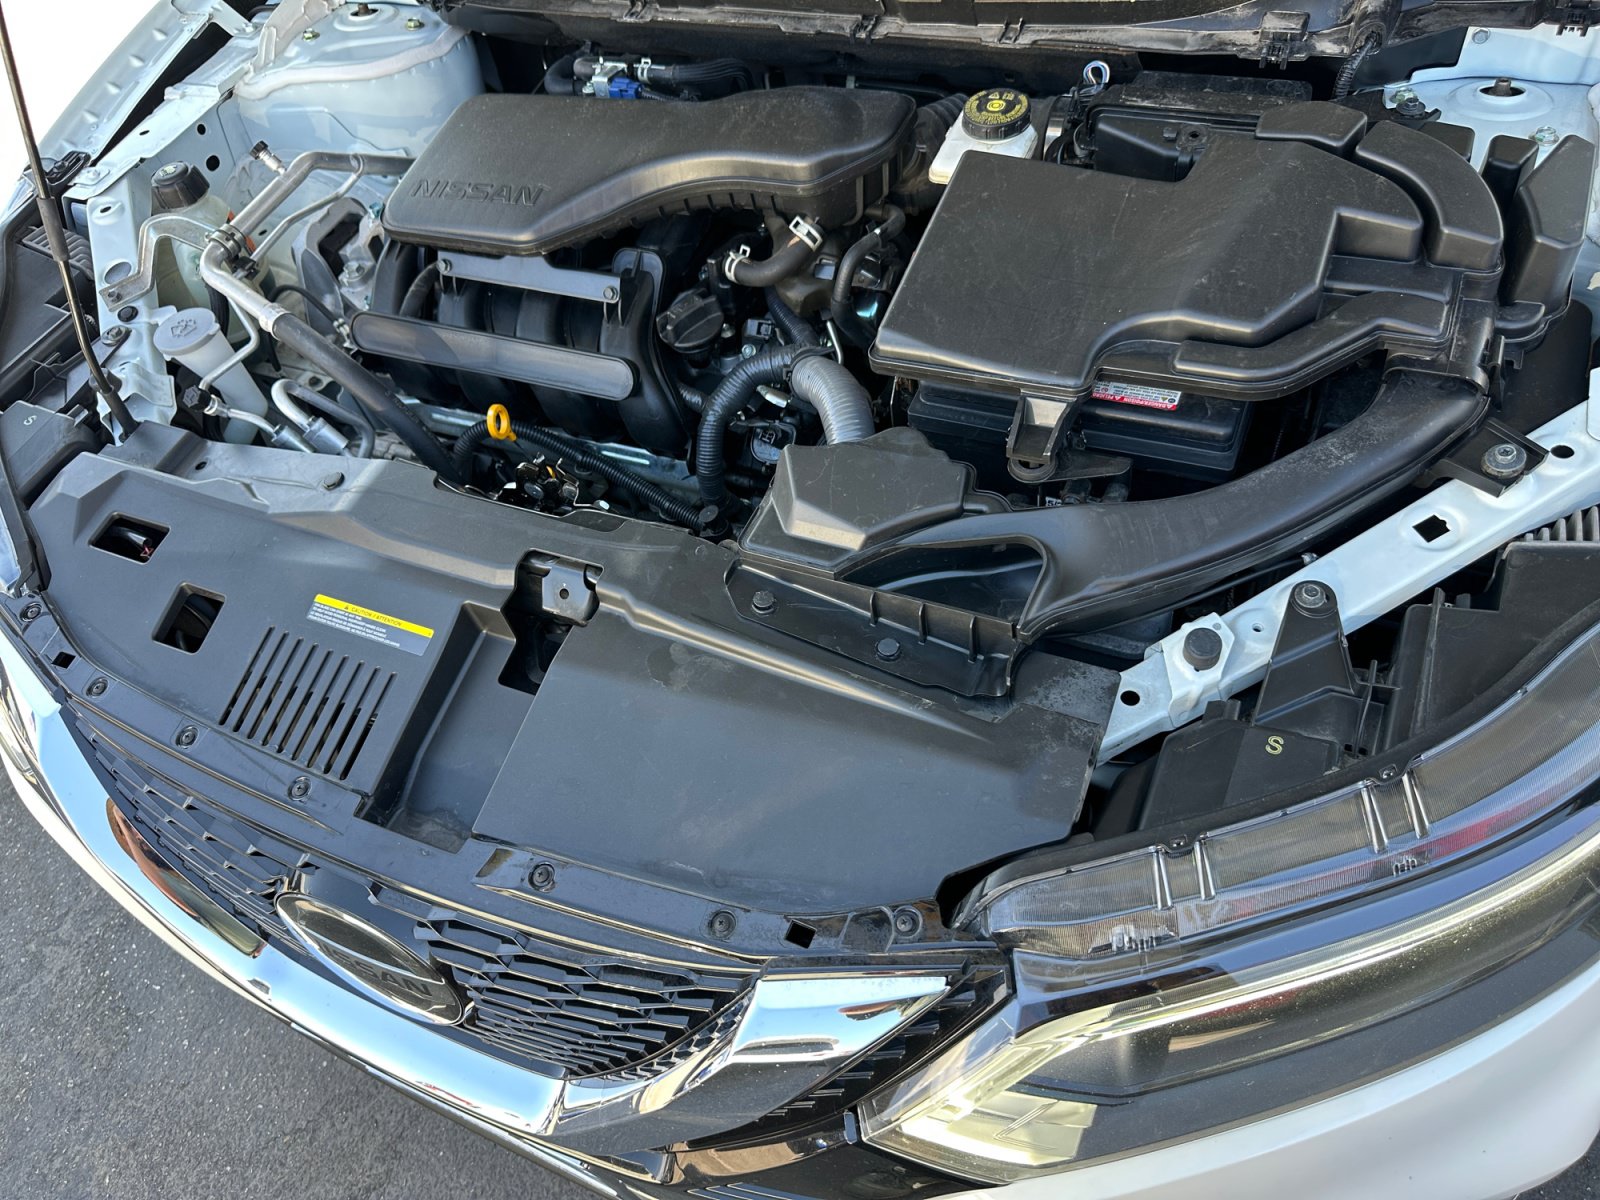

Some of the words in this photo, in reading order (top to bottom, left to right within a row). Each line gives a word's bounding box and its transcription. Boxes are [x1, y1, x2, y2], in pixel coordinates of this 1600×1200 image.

[410, 179, 545, 206] NISSAN
[351, 606, 372, 617] CAUTION
[376, 615, 402, 627] ATTENTION
[1265, 735, 1284, 755] S
